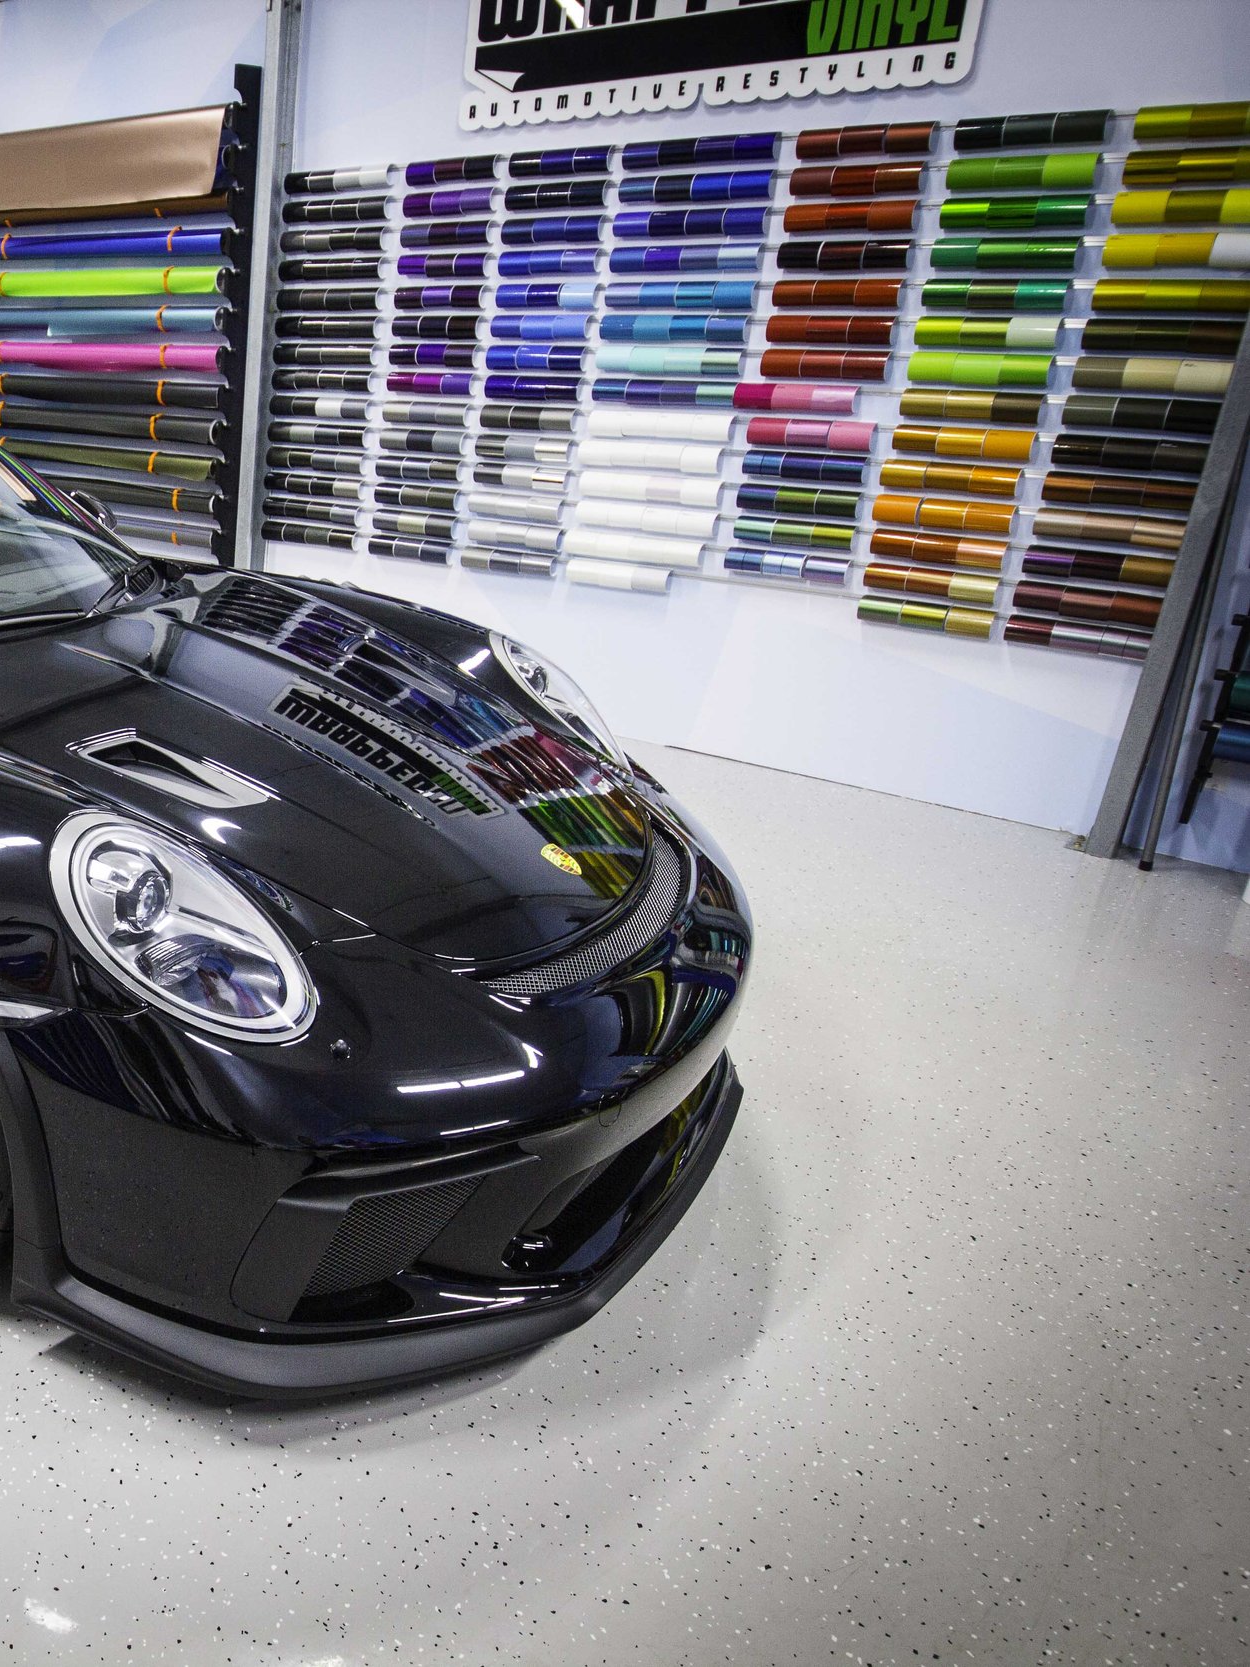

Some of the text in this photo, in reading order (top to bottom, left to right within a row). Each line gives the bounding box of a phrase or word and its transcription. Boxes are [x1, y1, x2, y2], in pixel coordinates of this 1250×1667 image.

[806, 0, 958, 54] VINYL
[469, 52, 956, 119] AUTOMOTIVE RESTYLING
